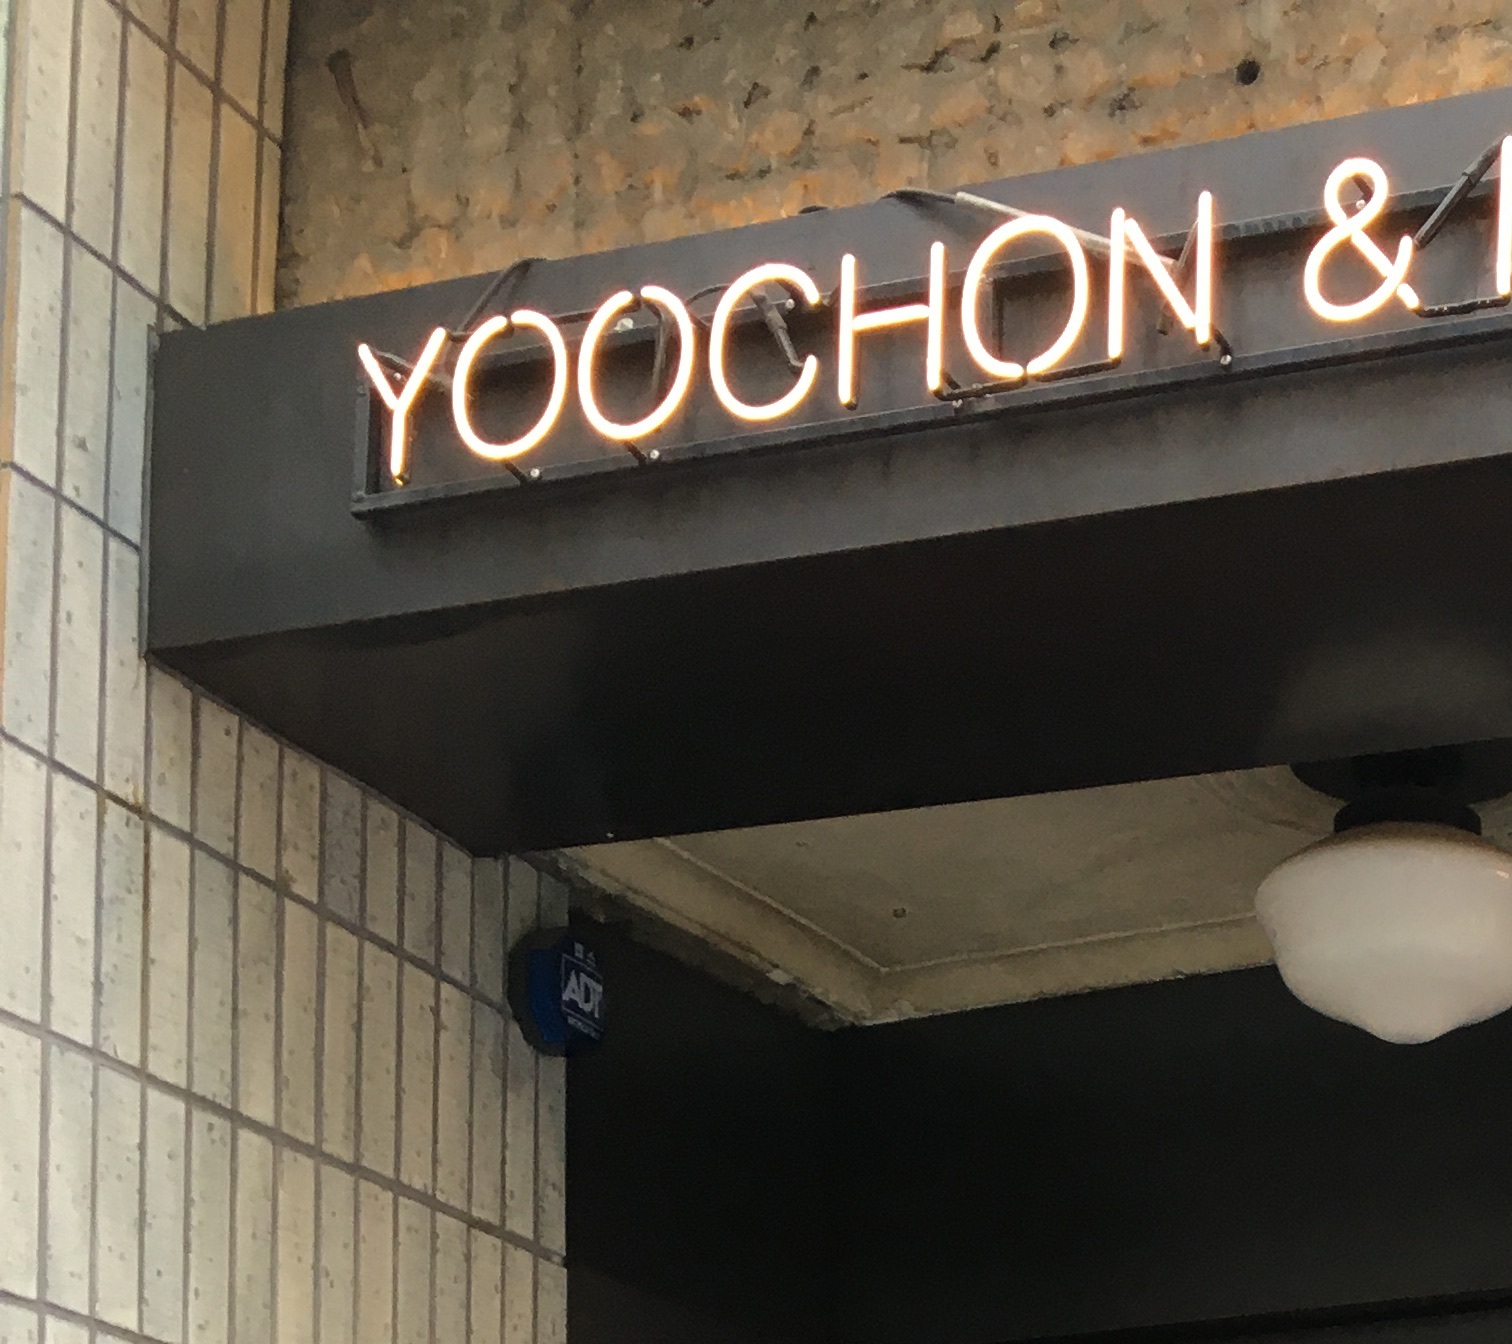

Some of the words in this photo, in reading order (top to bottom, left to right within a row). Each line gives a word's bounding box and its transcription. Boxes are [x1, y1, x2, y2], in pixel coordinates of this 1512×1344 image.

[357, 188, 1214, 484] YOOCHON
[1302, 156, 1422, 323] &
[562, 969, 603, 1018] ADT
